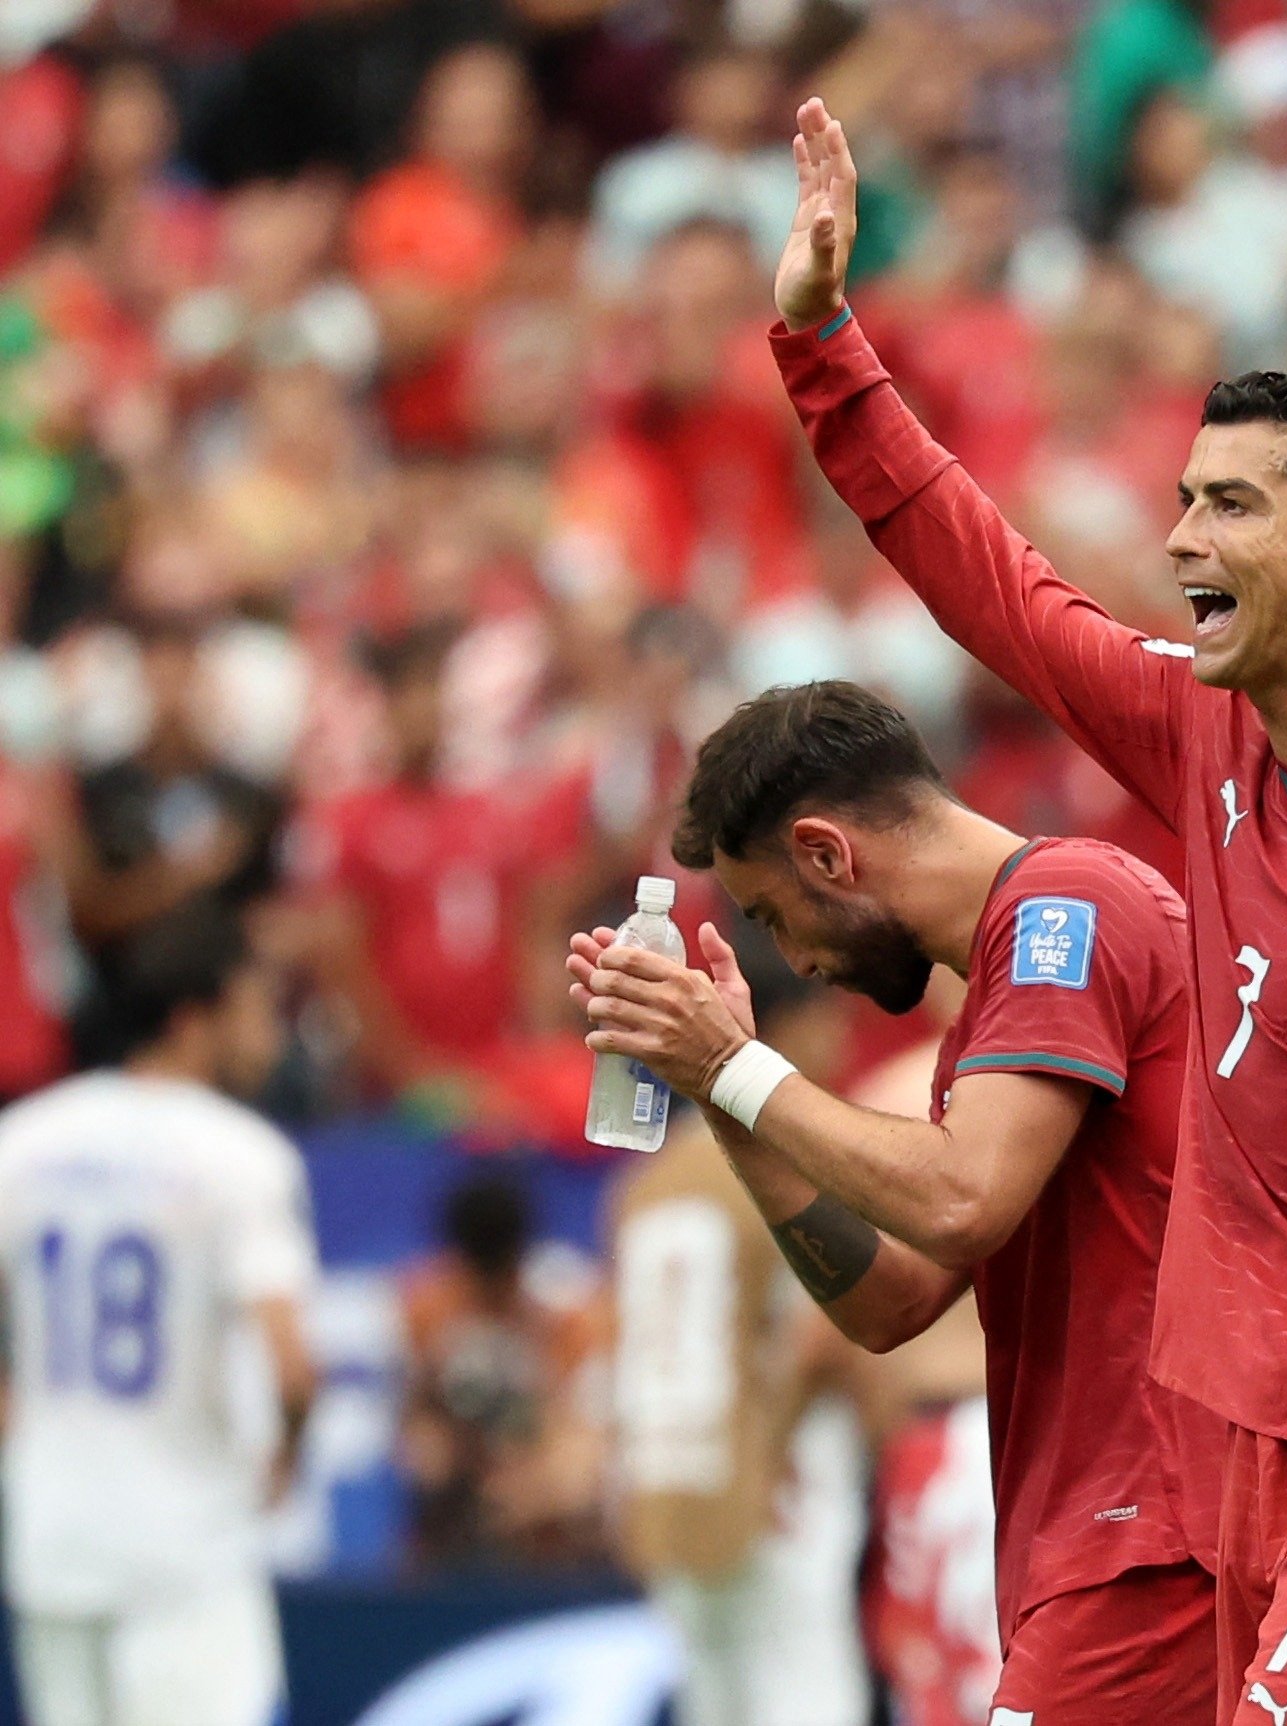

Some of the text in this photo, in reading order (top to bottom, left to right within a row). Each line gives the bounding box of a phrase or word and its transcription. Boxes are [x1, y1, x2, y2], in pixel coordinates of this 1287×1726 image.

[1030, 949, 1069, 967] PEACE
[1037, 965, 1060, 976] FIFA
[1216, 945, 1271, 1079] 7
[38, 1230, 163, 1400] 18
